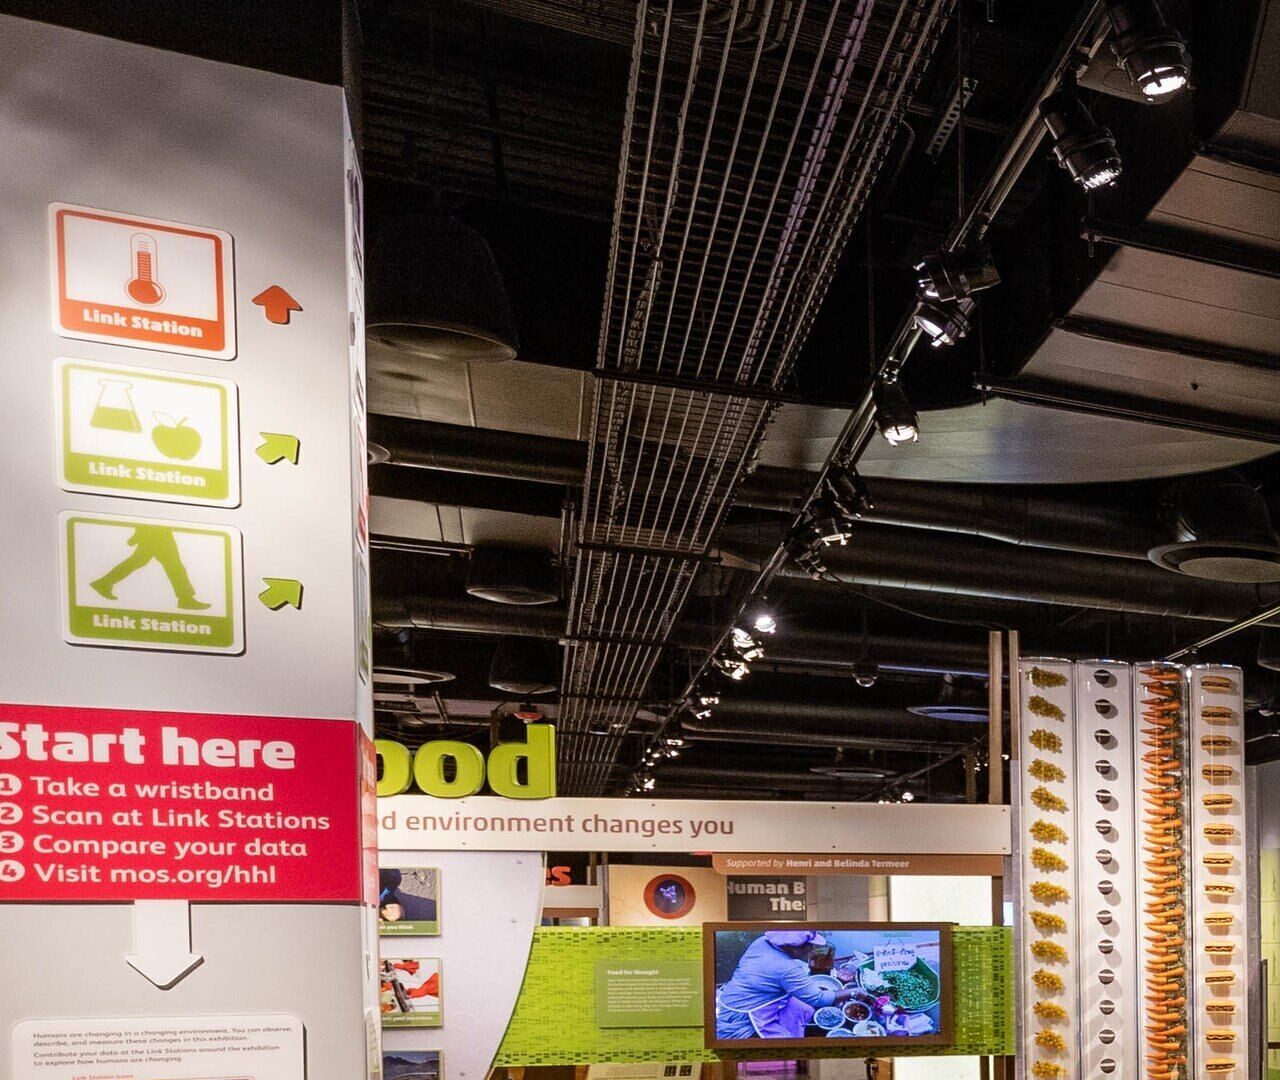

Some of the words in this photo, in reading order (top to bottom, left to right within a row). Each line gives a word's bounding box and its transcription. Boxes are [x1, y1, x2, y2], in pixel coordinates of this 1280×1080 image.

[83, 309, 128, 328] Link
[131, 314, 204, 339] Station
[88, 462, 131, 479] Link
[134, 467, 207, 488] Station
[92, 614, 137, 631] Link
[140, 617, 212, 636] Station
[0, 722, 146, 765] Start
[161, 726, 296, 770] here
[30, 776, 100, 797] Take
[108, 783, 127, 797] a
[135, 780, 274, 801] wristband
[32, 805, 103, 826] Scan
[112, 809, 143, 826] at
[152, 808, 210, 828] Link
[218, 809, 330, 830] Stations
[376, 811, 397, 831] d
[406, 812, 574, 833] environment
[582, 814, 682, 837] changes
[689, 820, 734, 837] you
[33, 834, 167, 859] Compare
[174, 840, 237, 860] your
[244, 838, 307, 857] data
[33, 863, 102, 882] Visit
[111, 864, 276, 888] mos.org/hhl
[726, 858, 776, 869] Supported
[777, 859, 784, 869] by
[786, 859, 812, 868] Henri
[813, 859, 832, 868] and
[834, 859, 870, 868] Belinda
[872, 860, 910, 868] Termeer
